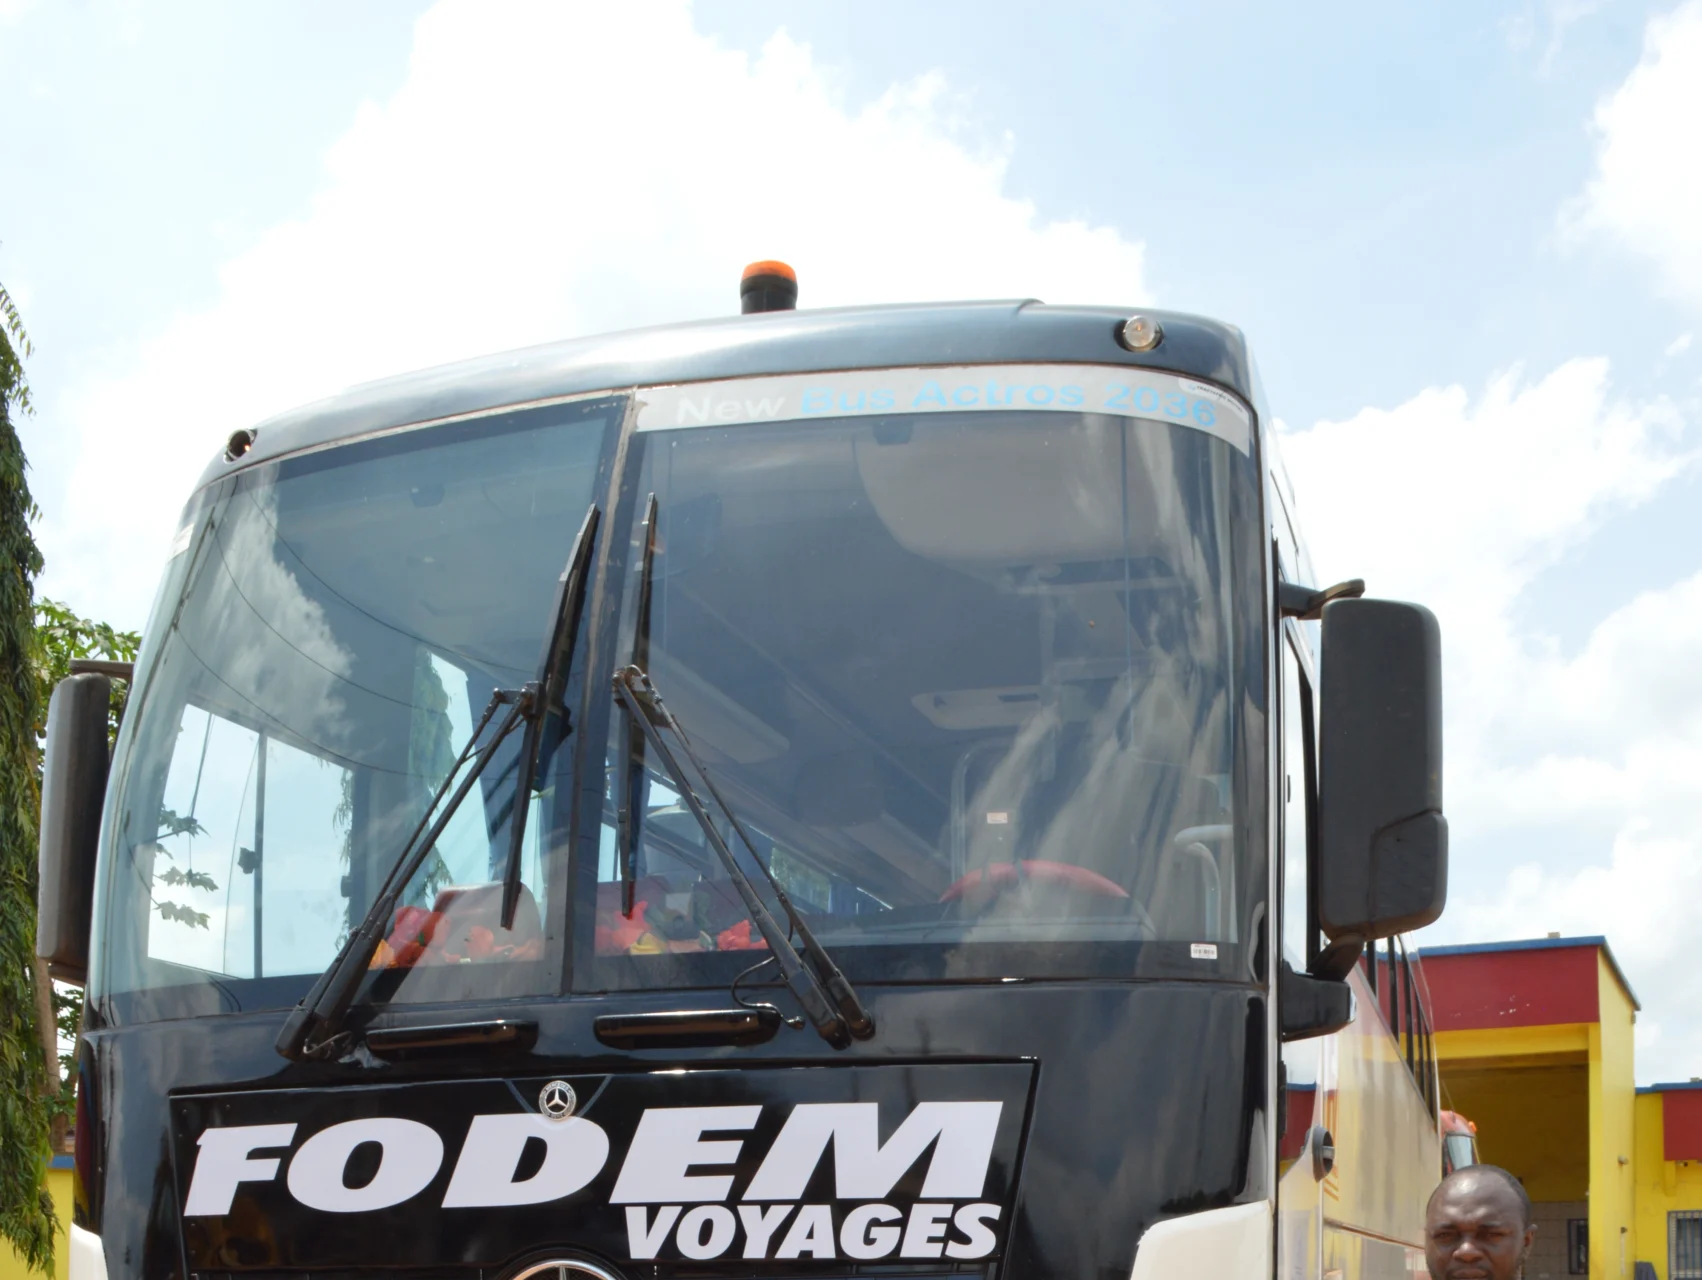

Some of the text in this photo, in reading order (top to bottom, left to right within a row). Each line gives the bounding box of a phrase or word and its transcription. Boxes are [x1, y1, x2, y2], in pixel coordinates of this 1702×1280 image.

[676, 395, 786, 424] New
[801, 387, 896, 415] Bus
[911, 378, 1086, 409] Actros
[1103, 382, 1217, 428] 2036
[184, 1101, 1003, 1217] FODEM
[625, 1203, 1002, 1260] VOYAGES
